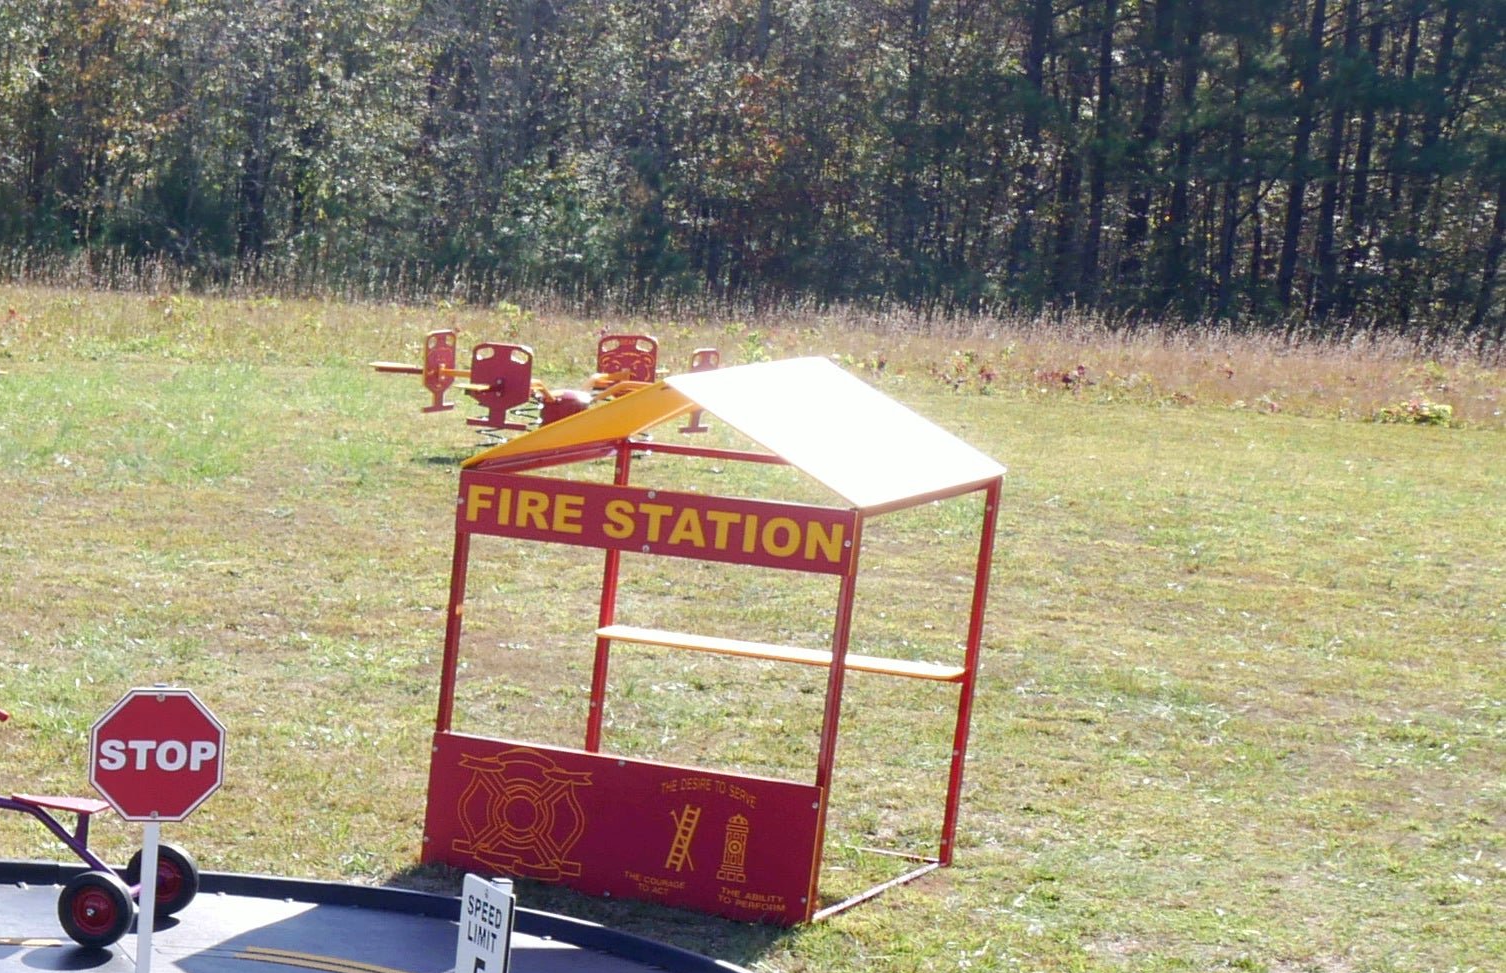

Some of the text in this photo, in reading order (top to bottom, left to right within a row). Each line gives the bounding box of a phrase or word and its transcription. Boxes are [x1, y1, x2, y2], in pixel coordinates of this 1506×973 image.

[466, 485, 844, 563] FIRE STATION
[99, 739, 217, 772] STOP
[661, 778, 757, 809] THE DESIRE TO SERVE
[624, 870, 686, 889] THE COURAGE
[638, 883, 669, 895] TO ACT
[722, 886, 784, 902] THE ABILITY
[467, 895, 502, 929] SPEED
[718, 894, 786, 912] TO PERFORM
[467, 920, 497, 953] LIMIT
